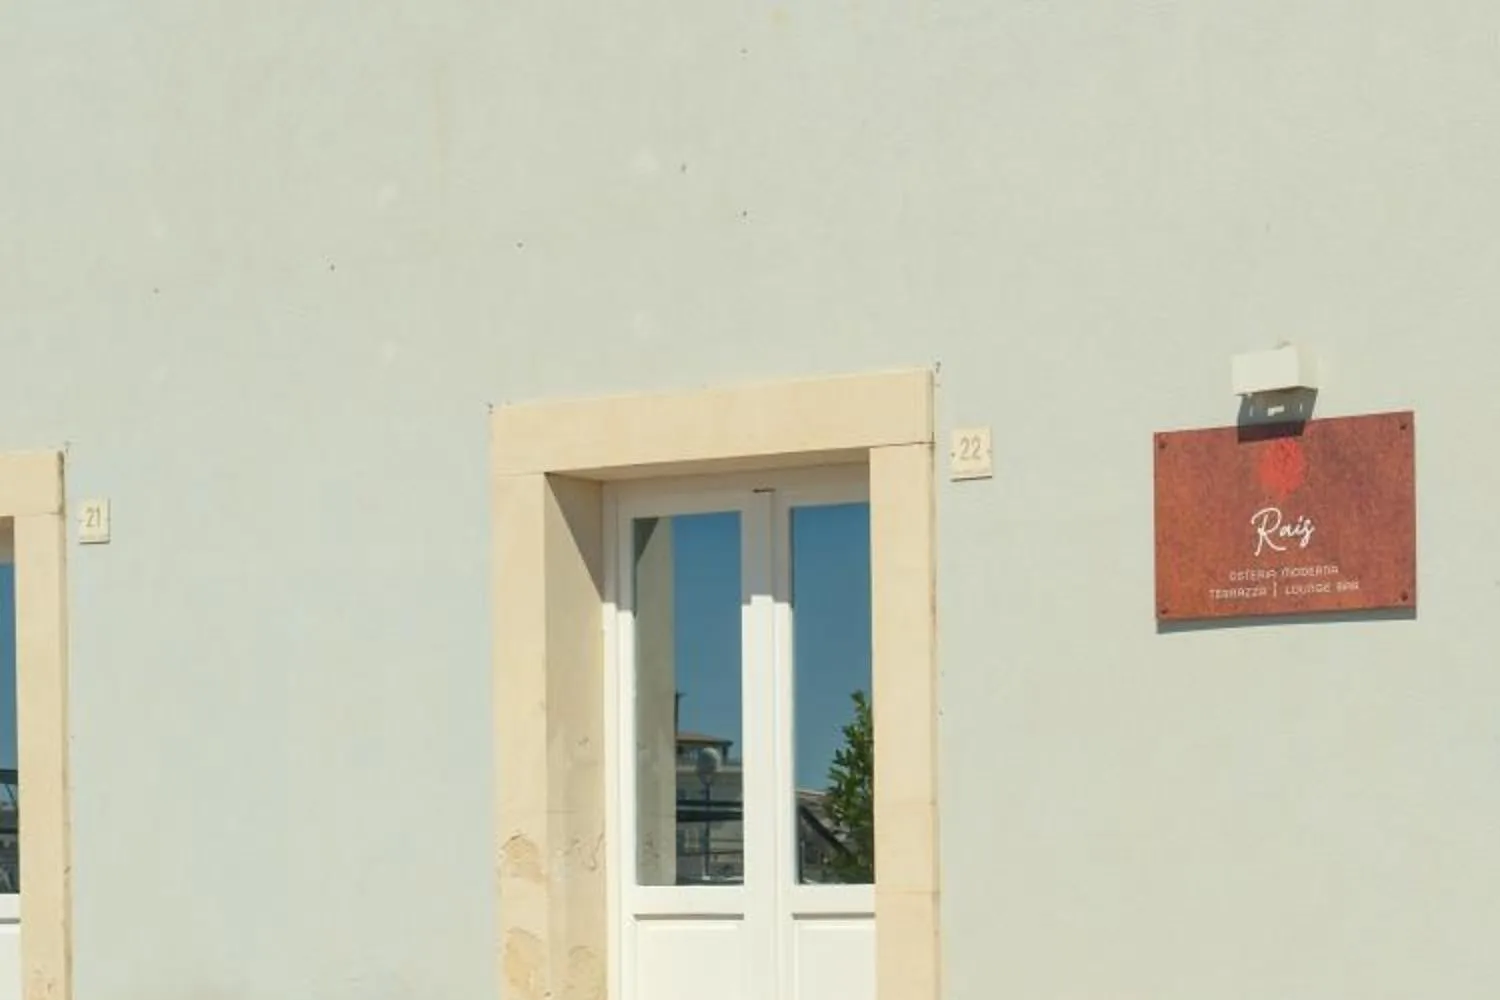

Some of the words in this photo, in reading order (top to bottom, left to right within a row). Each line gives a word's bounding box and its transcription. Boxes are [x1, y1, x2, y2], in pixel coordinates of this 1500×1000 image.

[960, 435, 981, 460] 22
[85, 506, 101, 528] 21
[1251, 507, 1316, 557] Rais
[1208, 586, 1267, 600] TERRAZZA
